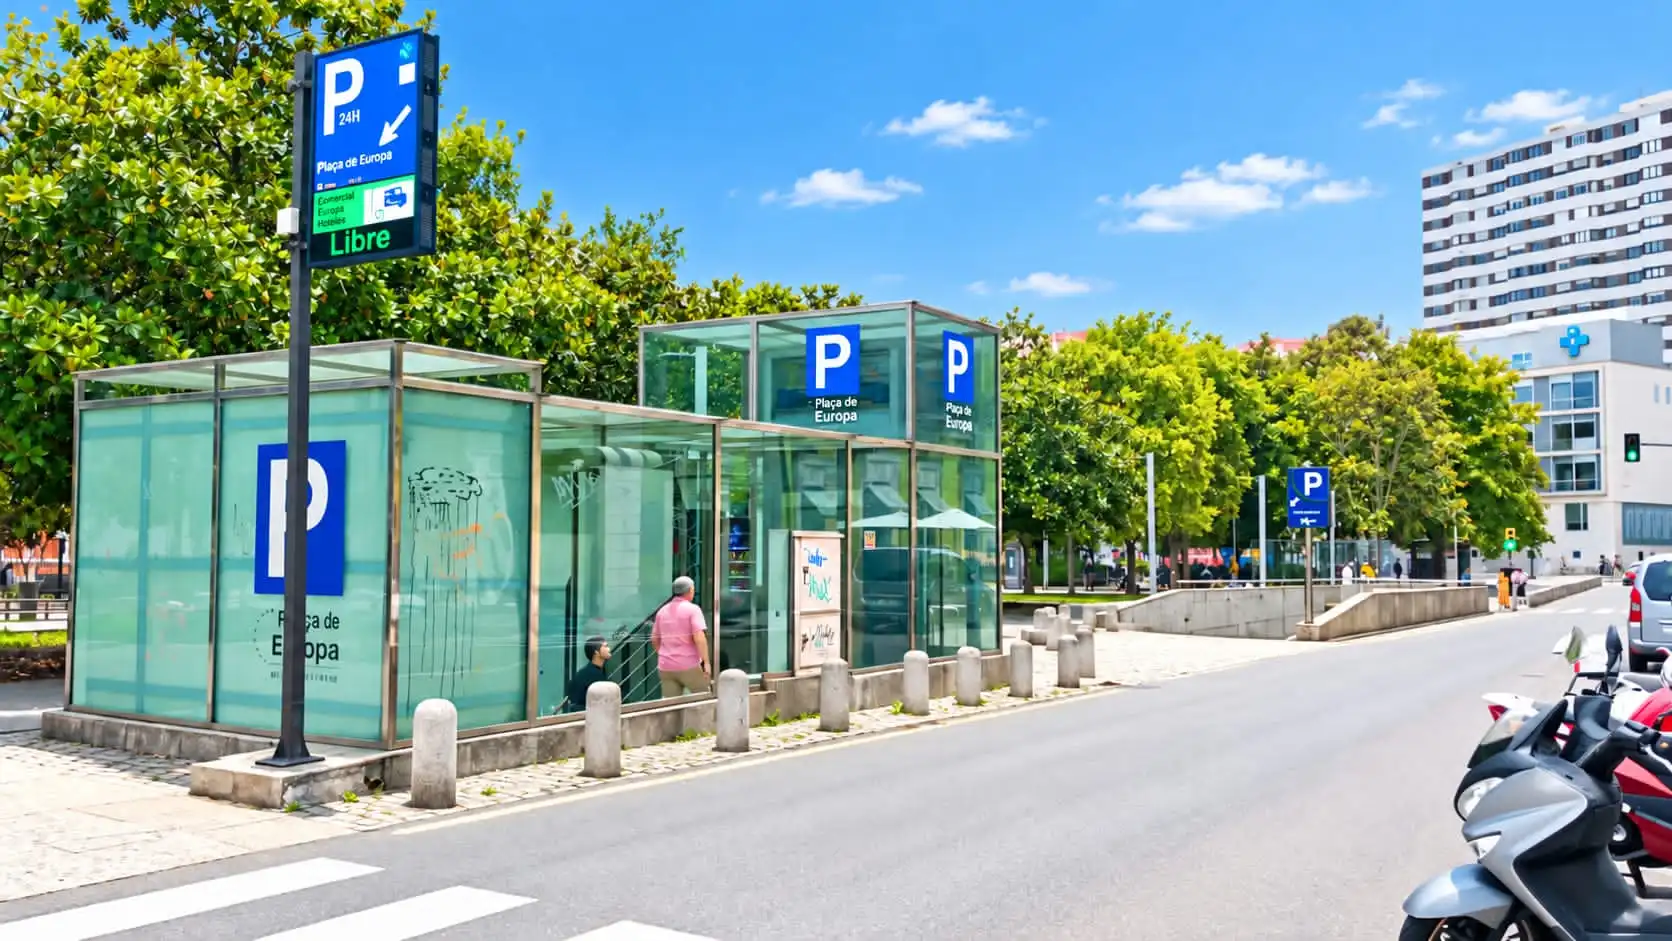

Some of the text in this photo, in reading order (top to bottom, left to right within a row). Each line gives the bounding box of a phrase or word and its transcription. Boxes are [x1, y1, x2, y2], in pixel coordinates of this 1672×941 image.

[323, 58, 364, 136] P
[339, 109, 360, 126] 24H
[317, 150, 392, 175] Plaça de Europa
[331, 229, 391, 256] Libre
[816, 334, 851, 389] P
[948, 339, 969, 393] P
[815, 396, 857, 410] Plaça de
[815, 410, 857, 424] Europa
[1304, 471, 1323, 496] P
[268, 458, 328, 577] P
[324, 611, 340, 629] de
[272, 634, 339, 664] Eopa
